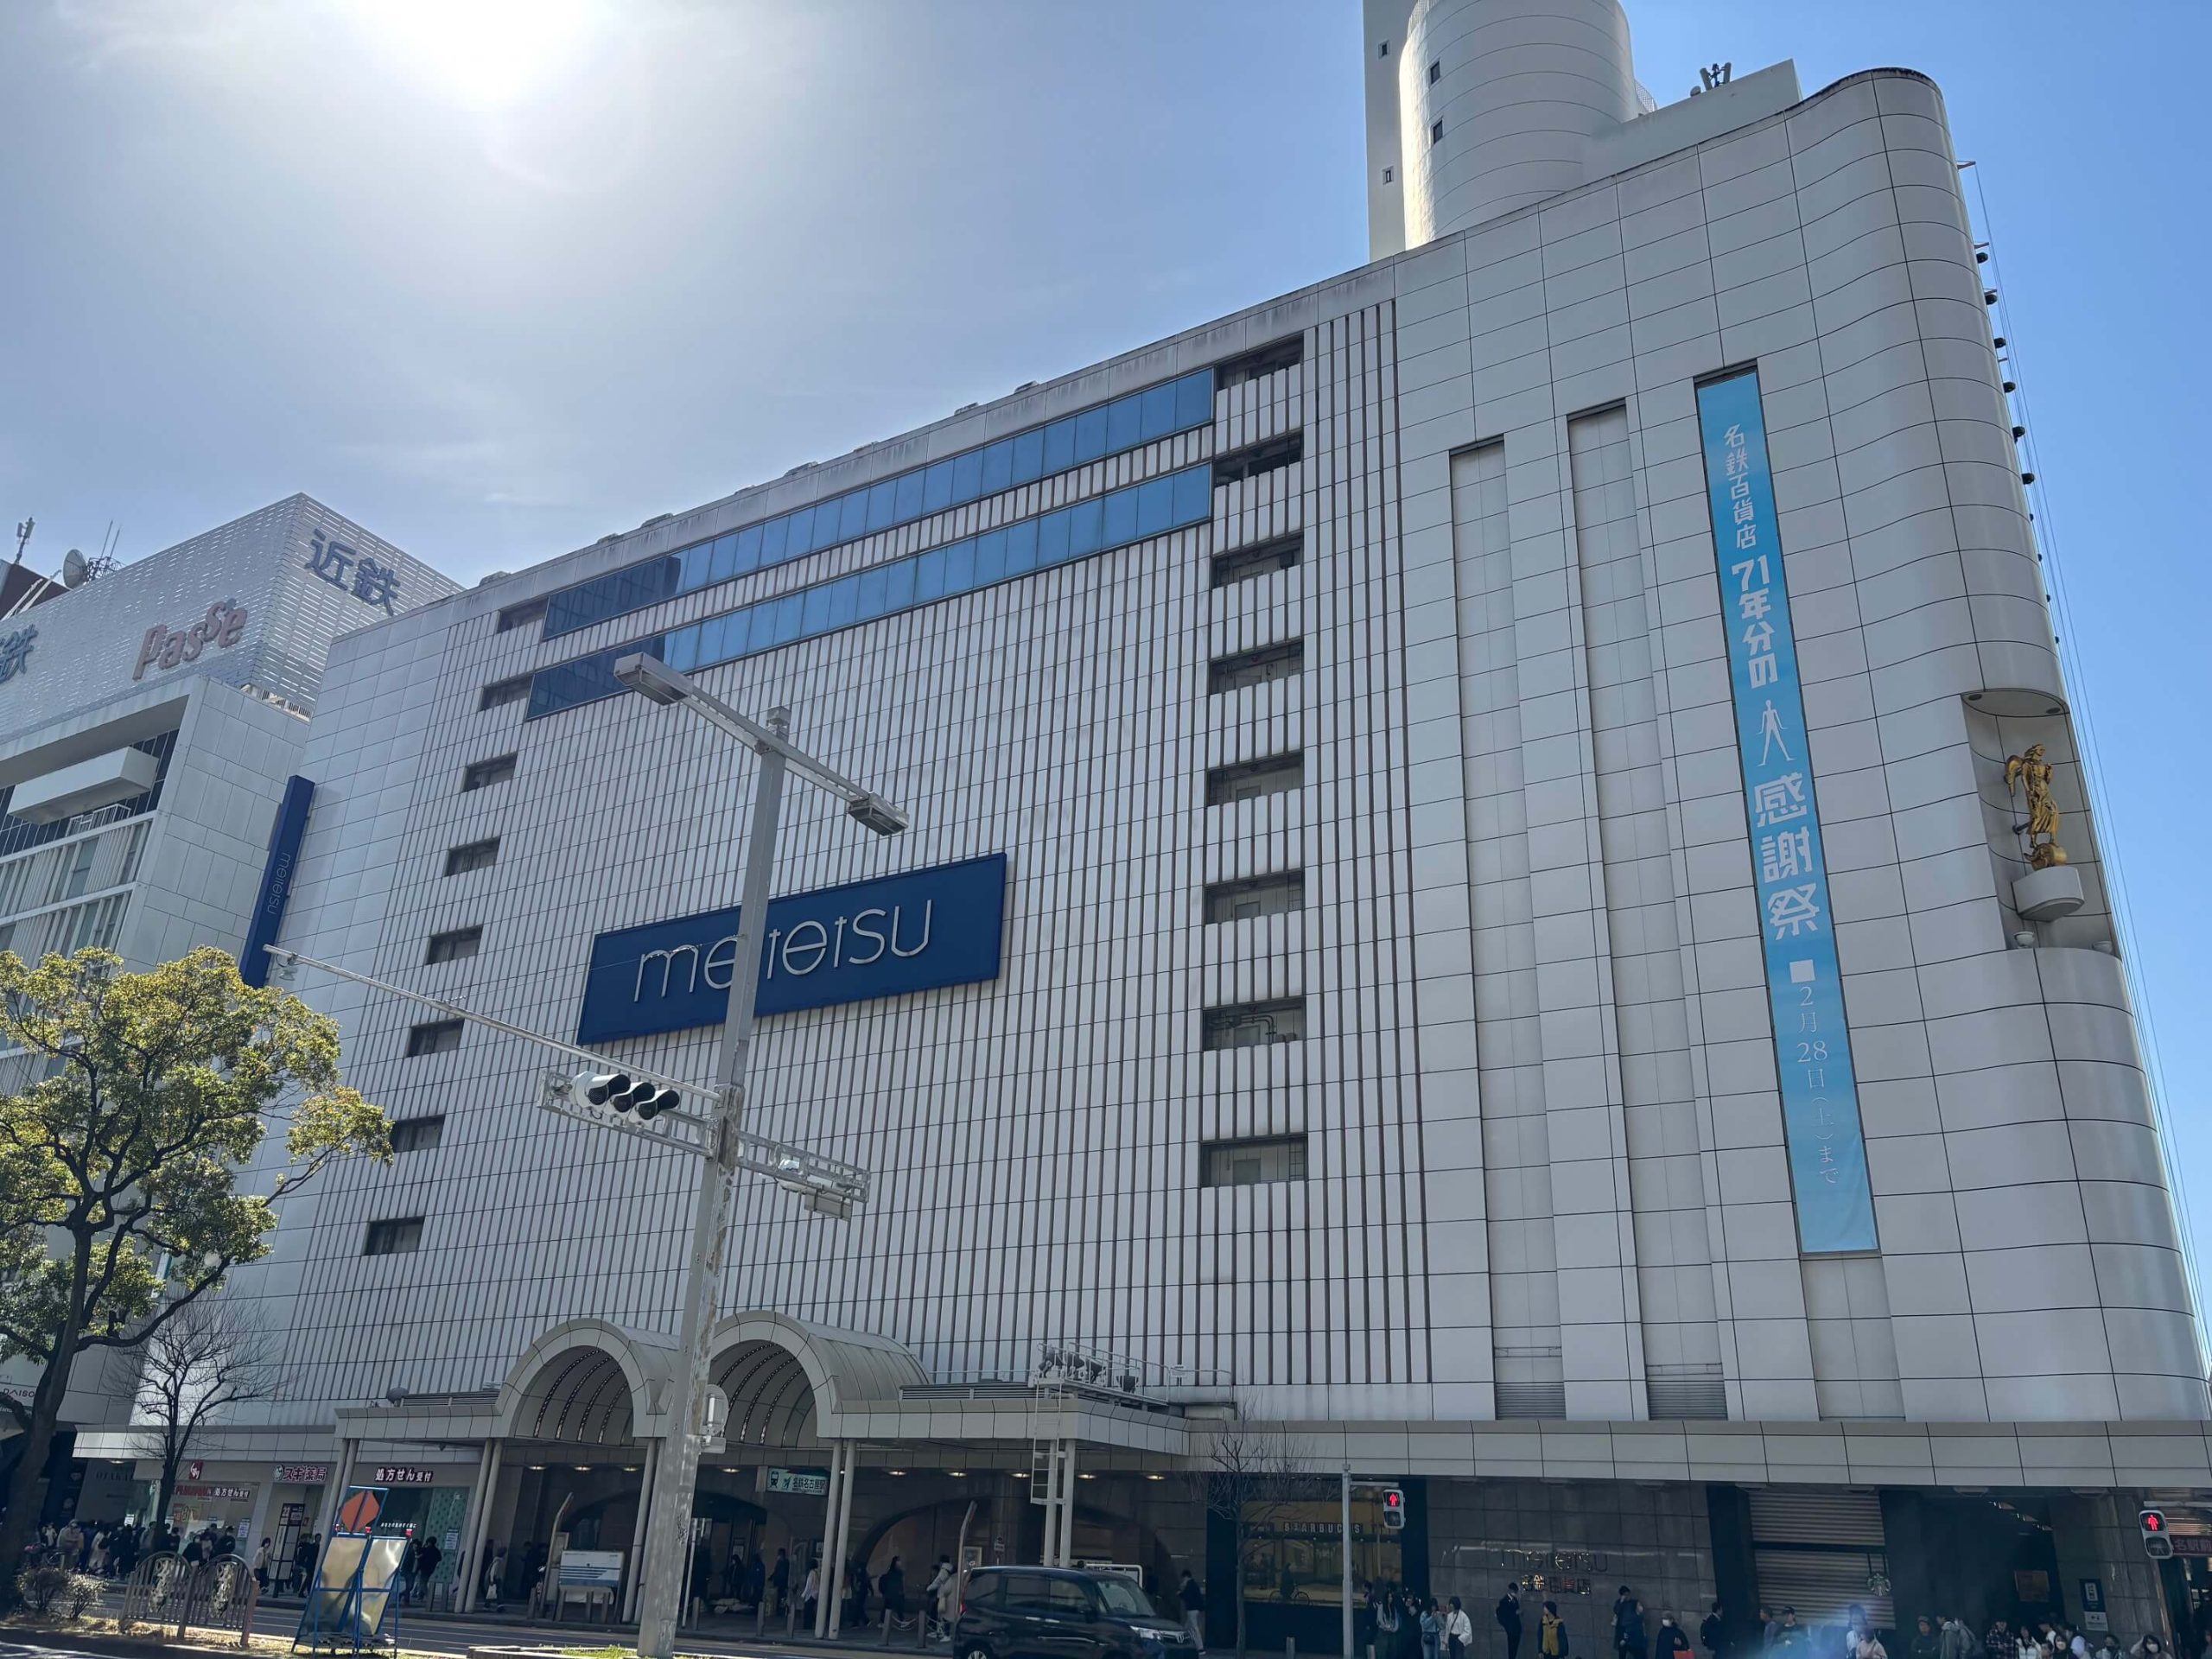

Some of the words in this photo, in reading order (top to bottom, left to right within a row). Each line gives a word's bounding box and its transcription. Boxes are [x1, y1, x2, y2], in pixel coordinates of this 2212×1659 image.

[1723, 423, 1757, 550] 名鉄百貨店
[304, 528, 401, 617] 近鉄
[1731, 554, 1779, 690] 71年分の
[1753, 772, 1821, 941] 感謝祭
[633, 899, 933, 1003] metetsu
[283, 1465, 327, 1482] スギ薬局
[375, 1467, 431, 1483] 処方せん受付
[1284, 1522, 1361, 1535] STARBUCS
